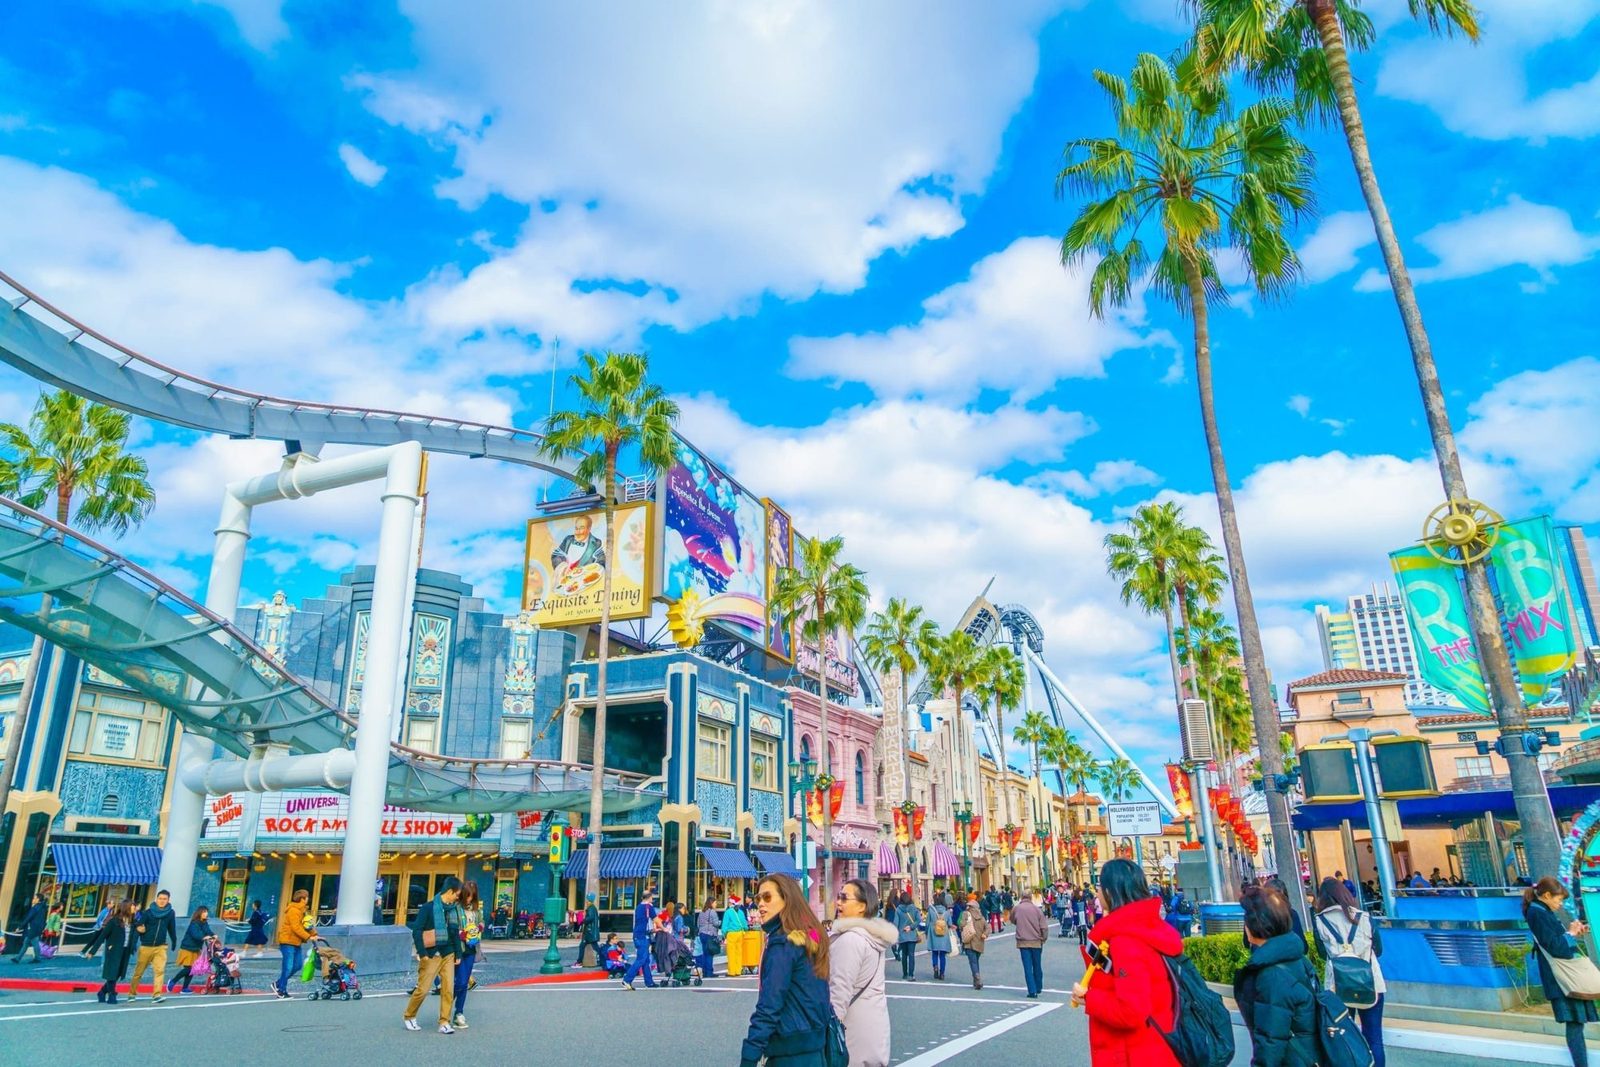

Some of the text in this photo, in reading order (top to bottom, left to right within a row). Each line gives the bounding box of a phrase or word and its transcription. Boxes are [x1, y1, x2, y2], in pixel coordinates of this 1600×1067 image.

[671, 475, 698, 507] Experience
[529, 587, 641, 616] Exquisite Dning
[1507, 600, 1564, 650] MIX
[212, 794, 233, 814] LIVE
[286, 797, 340, 814] UNIVERSAL
[216, 804, 243, 827] SHOW
[265, 817, 454, 836] ROCK AN LL SHOW
[570, 828, 587, 839] STOP
